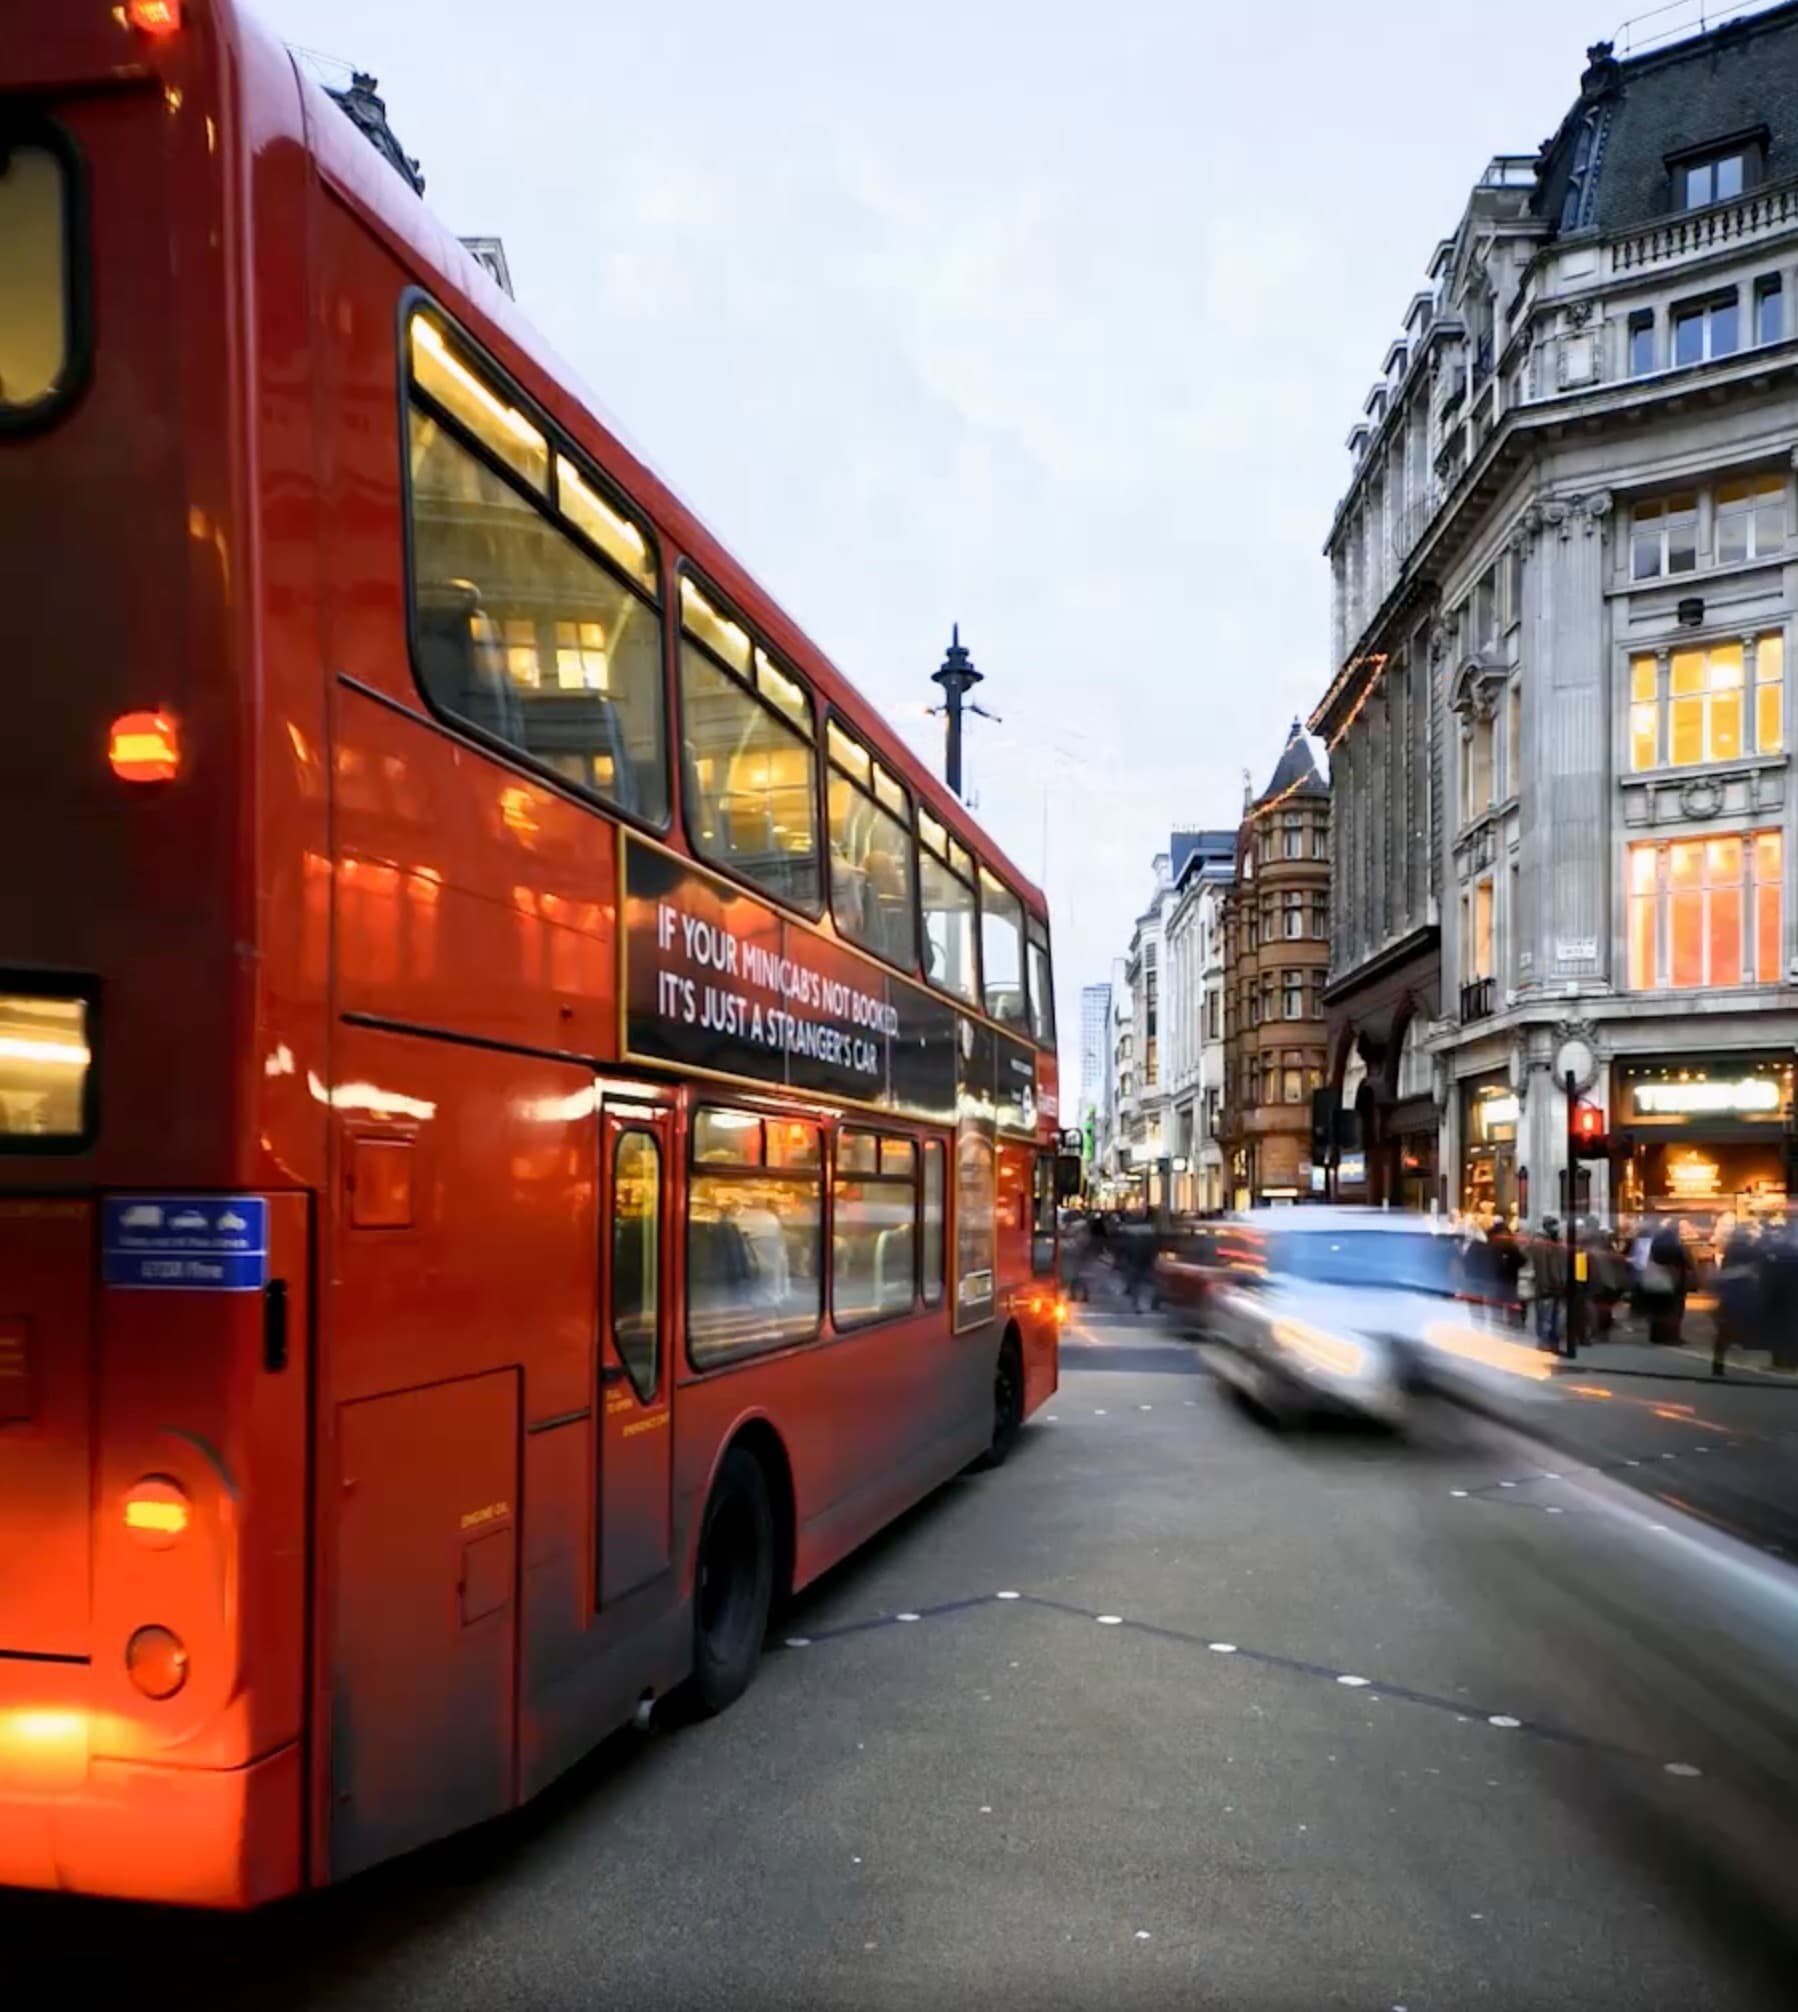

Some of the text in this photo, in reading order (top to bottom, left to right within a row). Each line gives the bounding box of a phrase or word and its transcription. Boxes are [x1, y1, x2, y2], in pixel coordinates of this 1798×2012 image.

[658, 903, 677, 951] IF
[681, 914, 739, 977] YOUR
[742, 940, 820, 1009] MINICAB'S
[822, 976, 851, 1019] NOT
[658, 970, 878, 1075] IT'S JUST A STRANGER'S CAR
